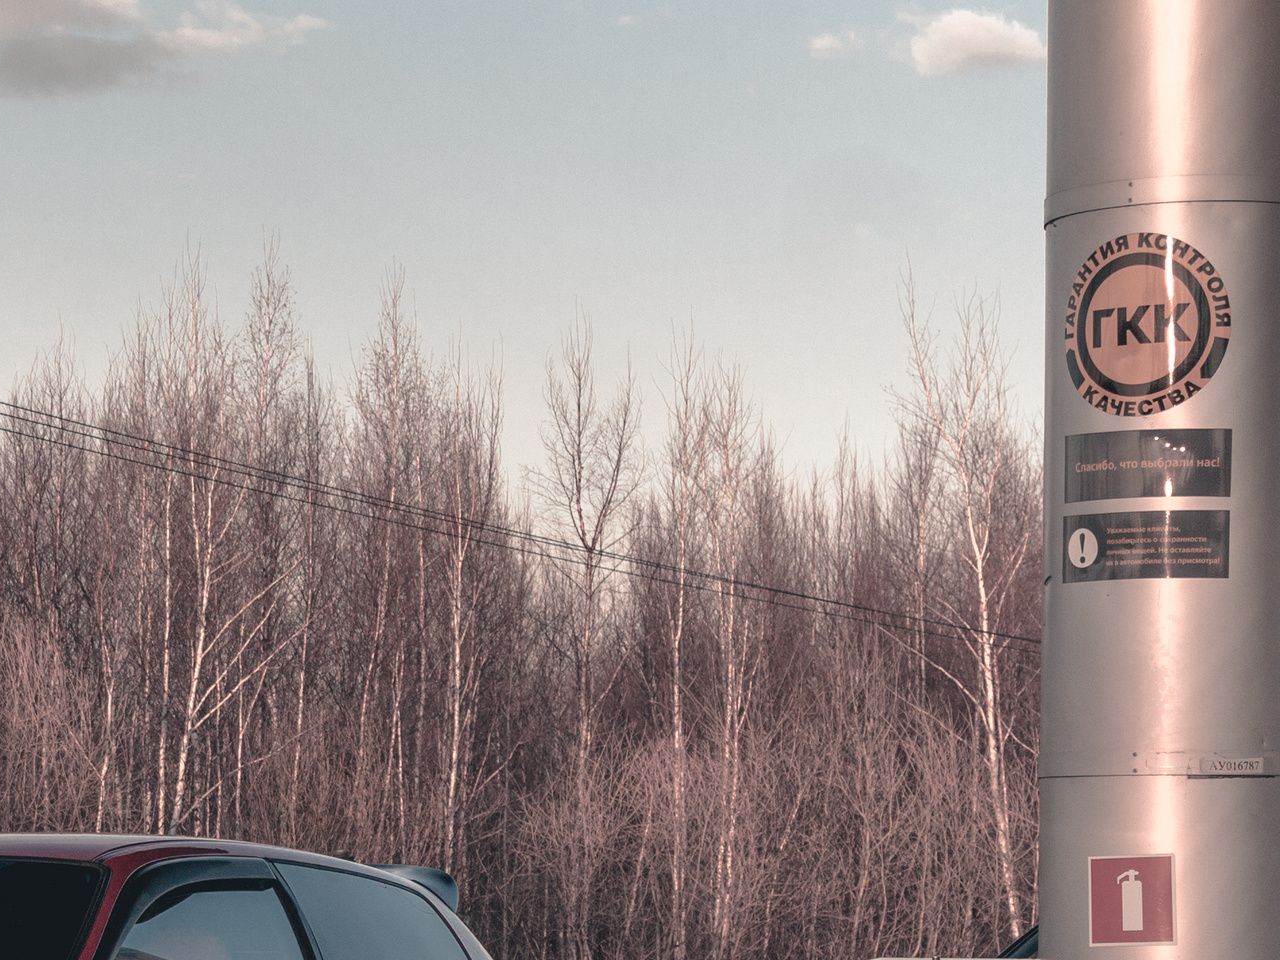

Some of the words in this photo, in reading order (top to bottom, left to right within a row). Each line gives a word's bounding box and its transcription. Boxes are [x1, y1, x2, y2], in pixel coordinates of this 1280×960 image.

[1064, 234, 1130, 341] ГАРАНТИЯ
[1137, 232, 1232, 328] КОНТРОЛЯ
[1092, 302, 1192, 349] ГКК
[1082, 380, 1203, 417] КАЧЕСТВА
[1075, 460, 1118, 473] Спасибо,
[1120, 460, 1139, 470] что
[1140, 457, 1194, 470] выбрали
[1196, 457, 1221, 468] нас!
[1210, 760, 1260, 771] АУ016787
